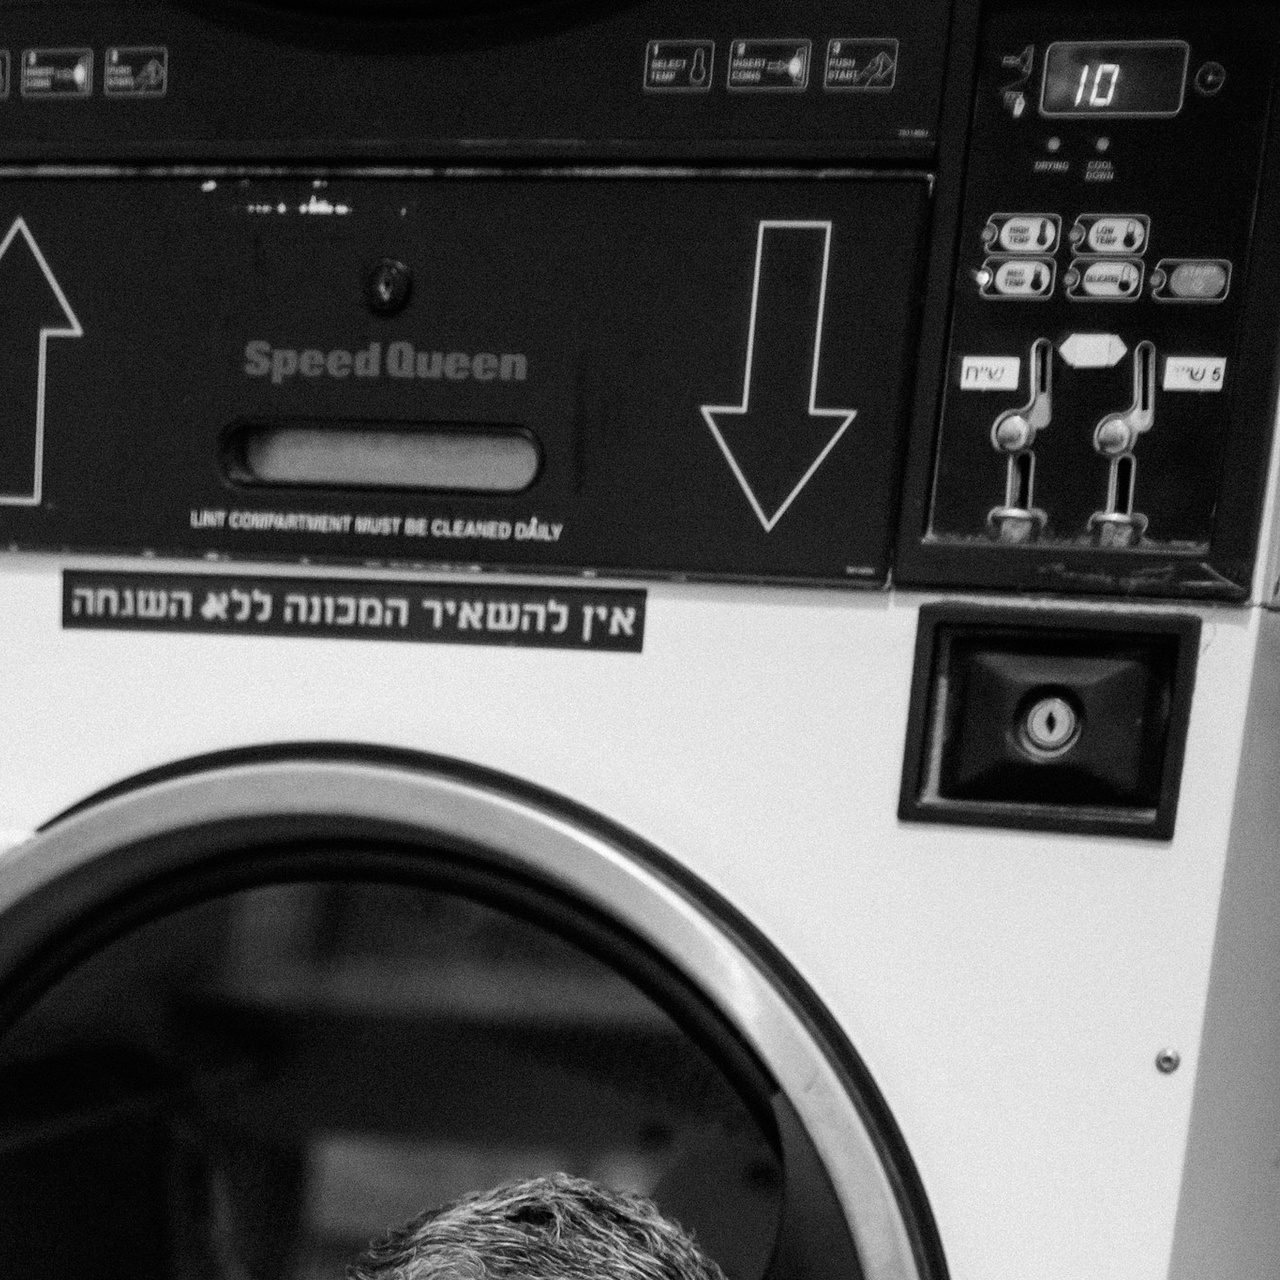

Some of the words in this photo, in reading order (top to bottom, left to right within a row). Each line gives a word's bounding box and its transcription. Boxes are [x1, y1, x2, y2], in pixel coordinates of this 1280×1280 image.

[652, 58, 686, 69] SELECT
[732, 58, 767, 69] INSERT
[829, 58, 856, 68] PUSH
[651, 71, 676, 80] TEMP
[828, 70, 858, 80] START
[1074, 64, 1120, 107] 10
[1033, 161, 1069, 171] DRYING
[1087, 160, 1113, 170] COOL
[1085, 171, 1114, 181] DOWN
[1096, 226, 1115, 235] LOW
[1008, 235, 1031, 244] TEMP
[1096, 236, 1117, 245] TEMP
[245, 340, 380, 384] Speed
[385, 341, 528, 381] Queen
[228, 511, 353, 534] COMPARTMENT
[354, 515, 402, 536] MUST
[404, 516, 428, 537] BE
[431, 517, 512, 540] CLEANED
[200, 587, 273, 622] ללא
[283, 594, 410, 628] המכונה
[422, 598, 569, 633] להשאיר
[582, 604, 638, 642] אין
